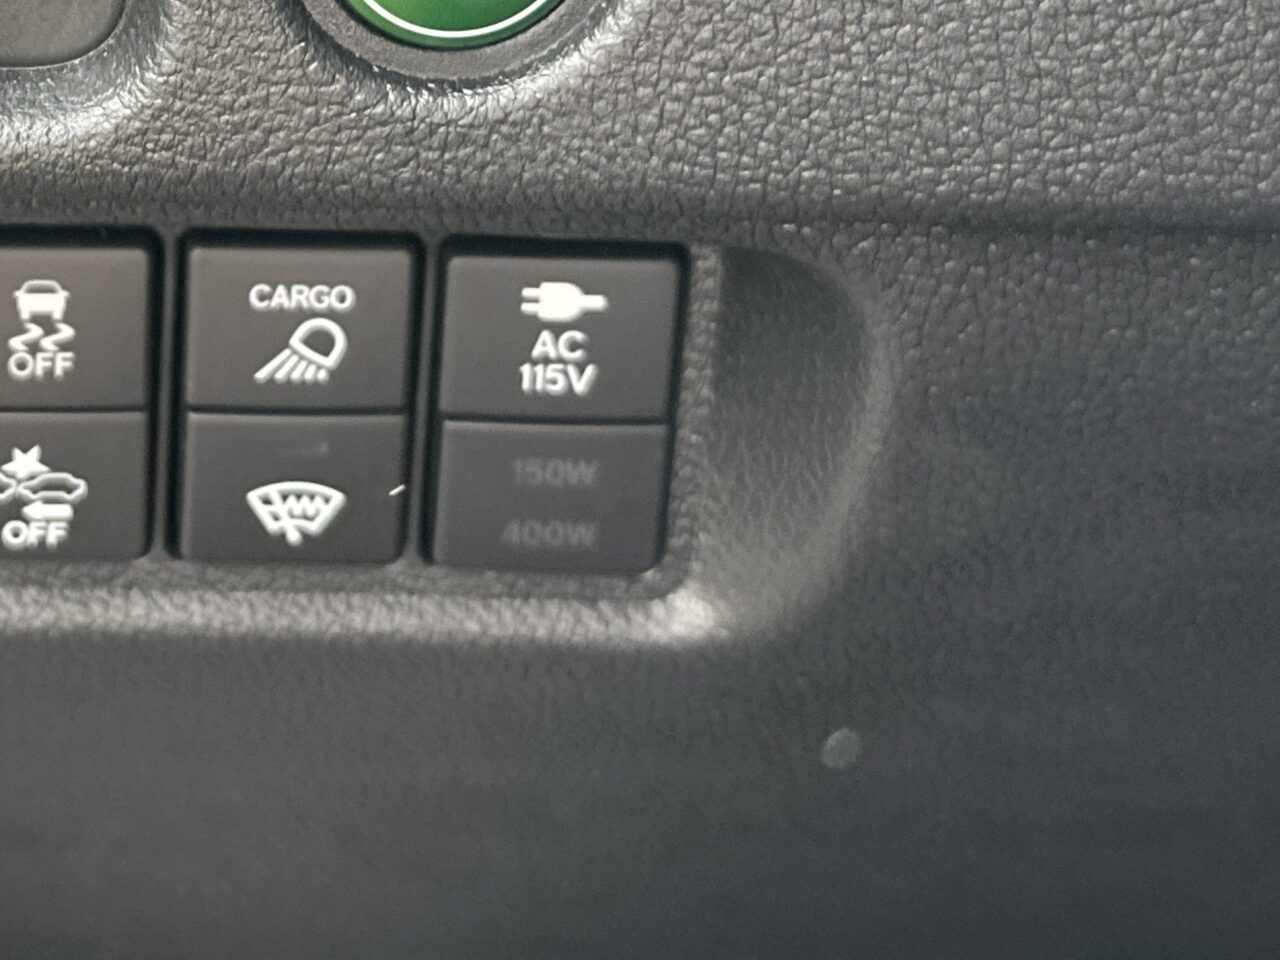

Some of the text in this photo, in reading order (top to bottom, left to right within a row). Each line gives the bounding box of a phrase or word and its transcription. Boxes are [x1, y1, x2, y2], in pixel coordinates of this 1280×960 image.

[248, 283, 356, 312] CARGO
[530, 330, 589, 361] AC
[8, 351, 75, 381] OFF
[519, 363, 598, 395] 115V
[515, 458, 600, 487] 150W
[1, 520, 69, 550] OFF
[504, 520, 600, 548] 400W
